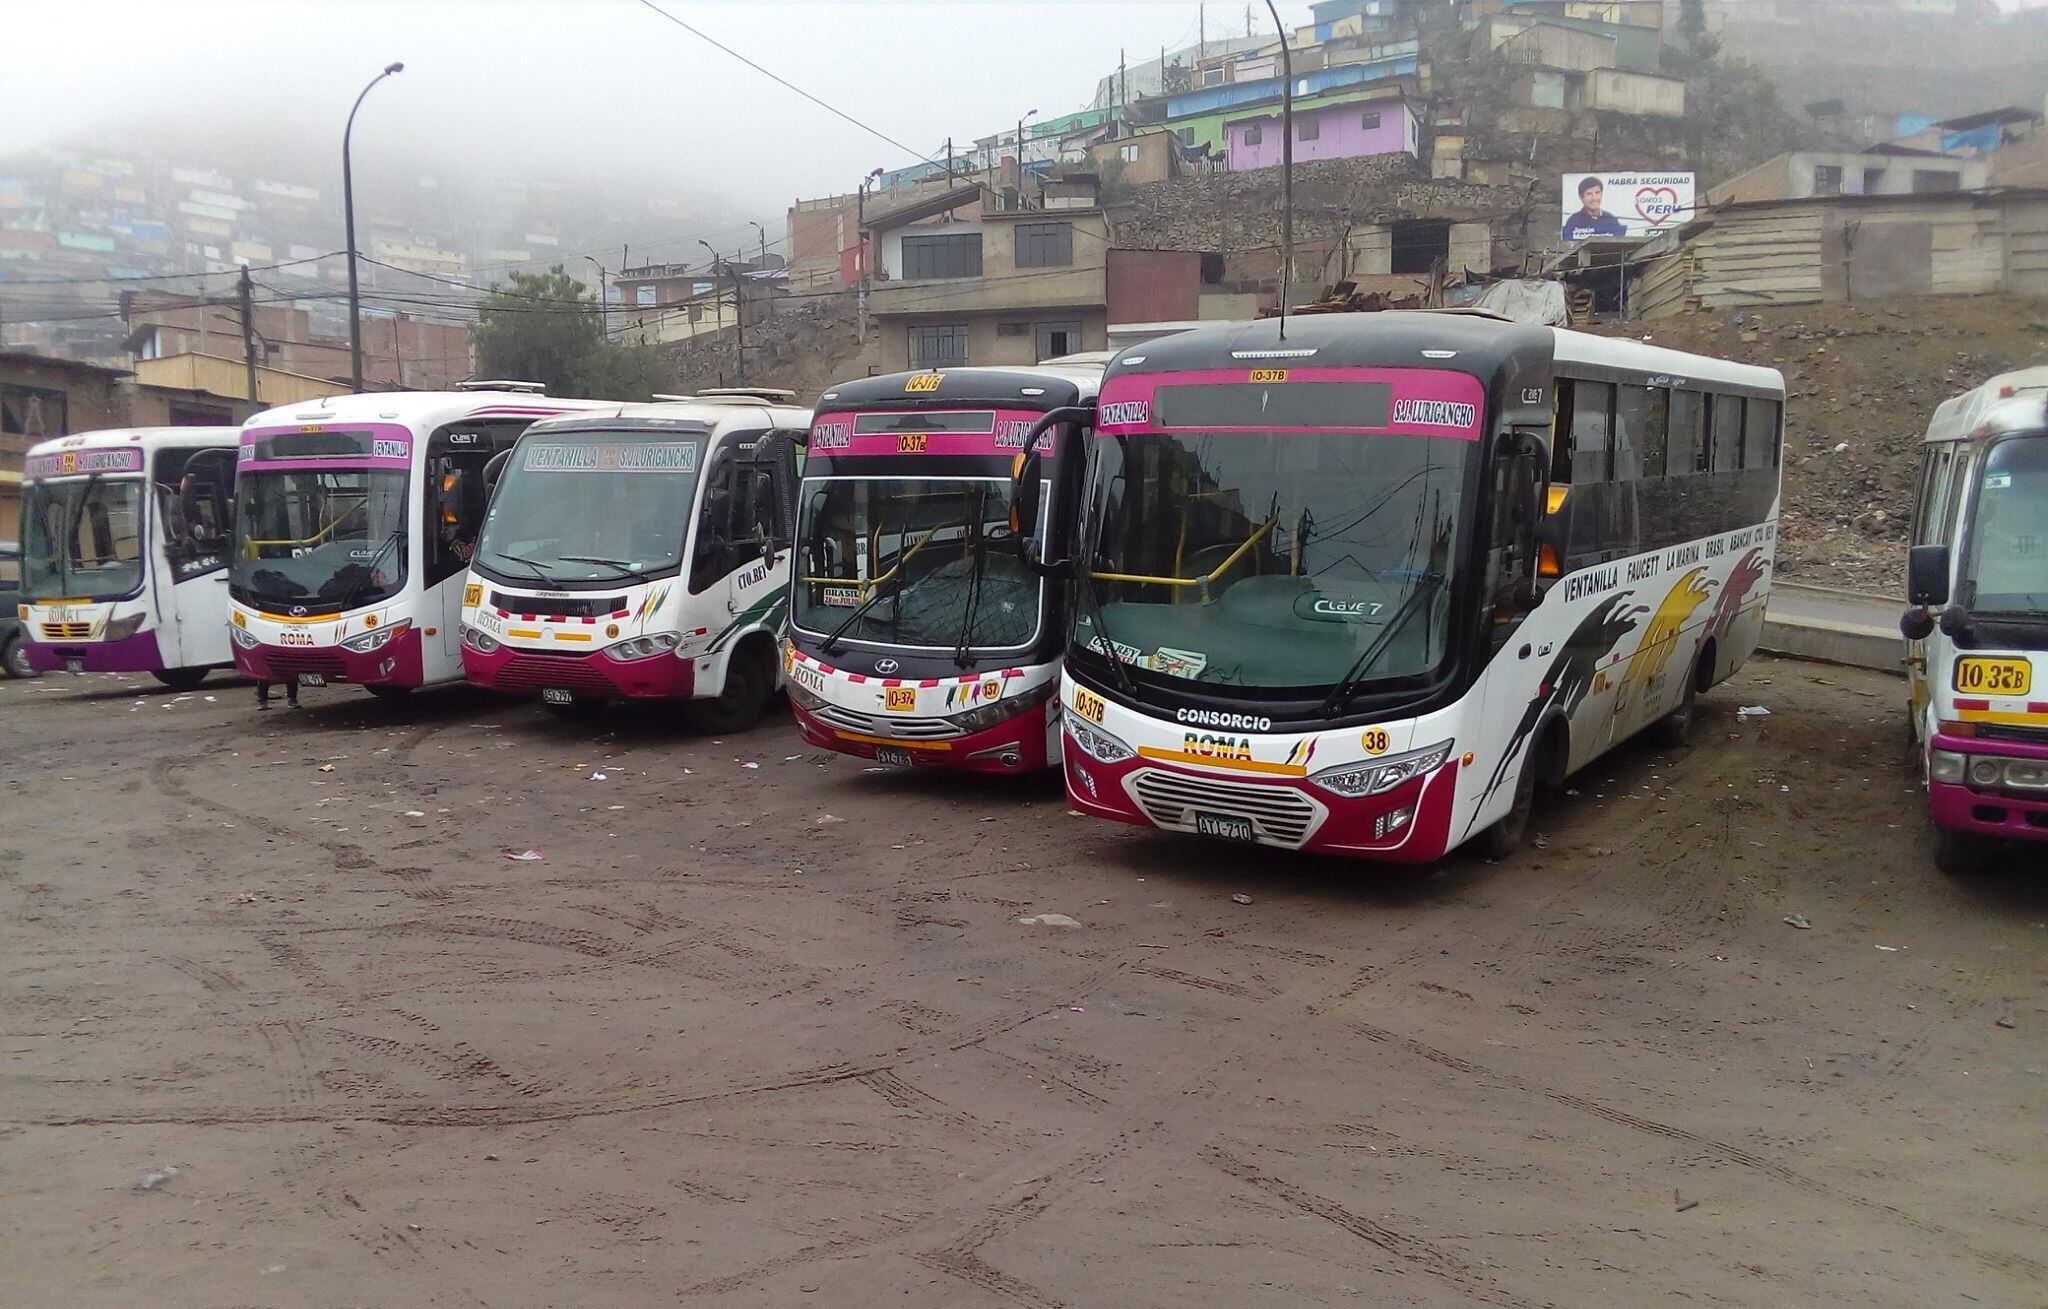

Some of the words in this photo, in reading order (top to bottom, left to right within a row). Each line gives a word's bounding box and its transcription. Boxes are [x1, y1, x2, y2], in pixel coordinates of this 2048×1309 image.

[1608, 177, 1637, 186] HABRA
[1640, 176, 1690, 185] SEGURIDAD
[1635, 196, 1663, 204] SOMOS
[1412, 401, 1475, 428] LURIGANCHO
[528, 446, 598, 468] VENTANILLA
[1564, 566, 1618, 604] VENTANILLA
[1626, 555, 1660, 584] FAUCETT
[1666, 551, 1675, 572] LA
[1675, 544, 1700, 569] MARINA
[1705, 538, 1724, 560] BRASIL
[1729, 530, 1753, 552] ABANCAY
[825, 589, 858, 598] BRASIL
[1370, 602, 1383, 616] 7
[364, 615, 378, 628] 46
[477, 613, 502, 635] ROMA
[279, 633, 316, 647] ROMA
[793, 666, 824, 692] ROMA
[983, 683, 998, 697] 137
[1176, 708, 1272, 732] CONSORCIO
[1183, 732, 1253, 761] ROMA
[1365, 731, 1387, 751] 38
